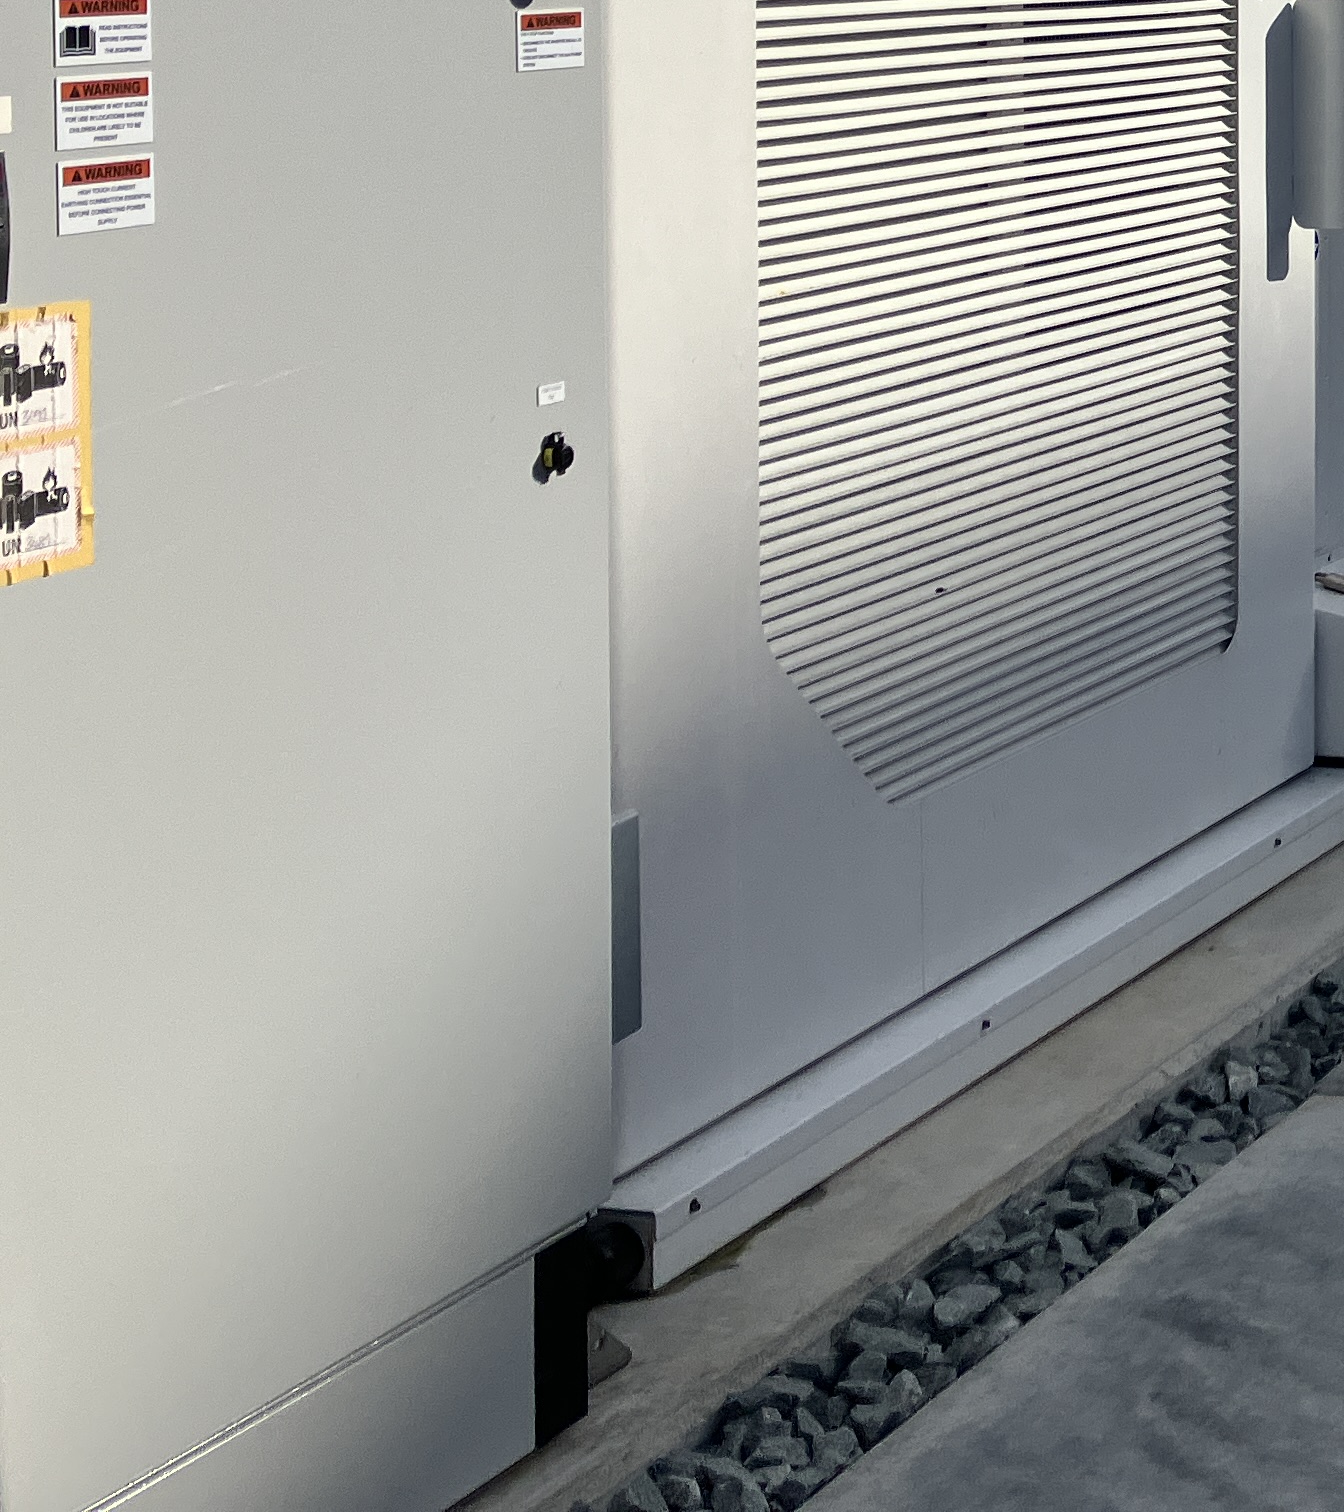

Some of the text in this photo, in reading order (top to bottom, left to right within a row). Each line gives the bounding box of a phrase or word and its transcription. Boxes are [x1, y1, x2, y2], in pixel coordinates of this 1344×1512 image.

[81, 0, 139, 14] WARNING
[82, 81, 141, 97] WARNING
[84, 163, 143, 181] WARNING
[0, 410, 18, 429] UN
[2, 537, 21, 557] UN
